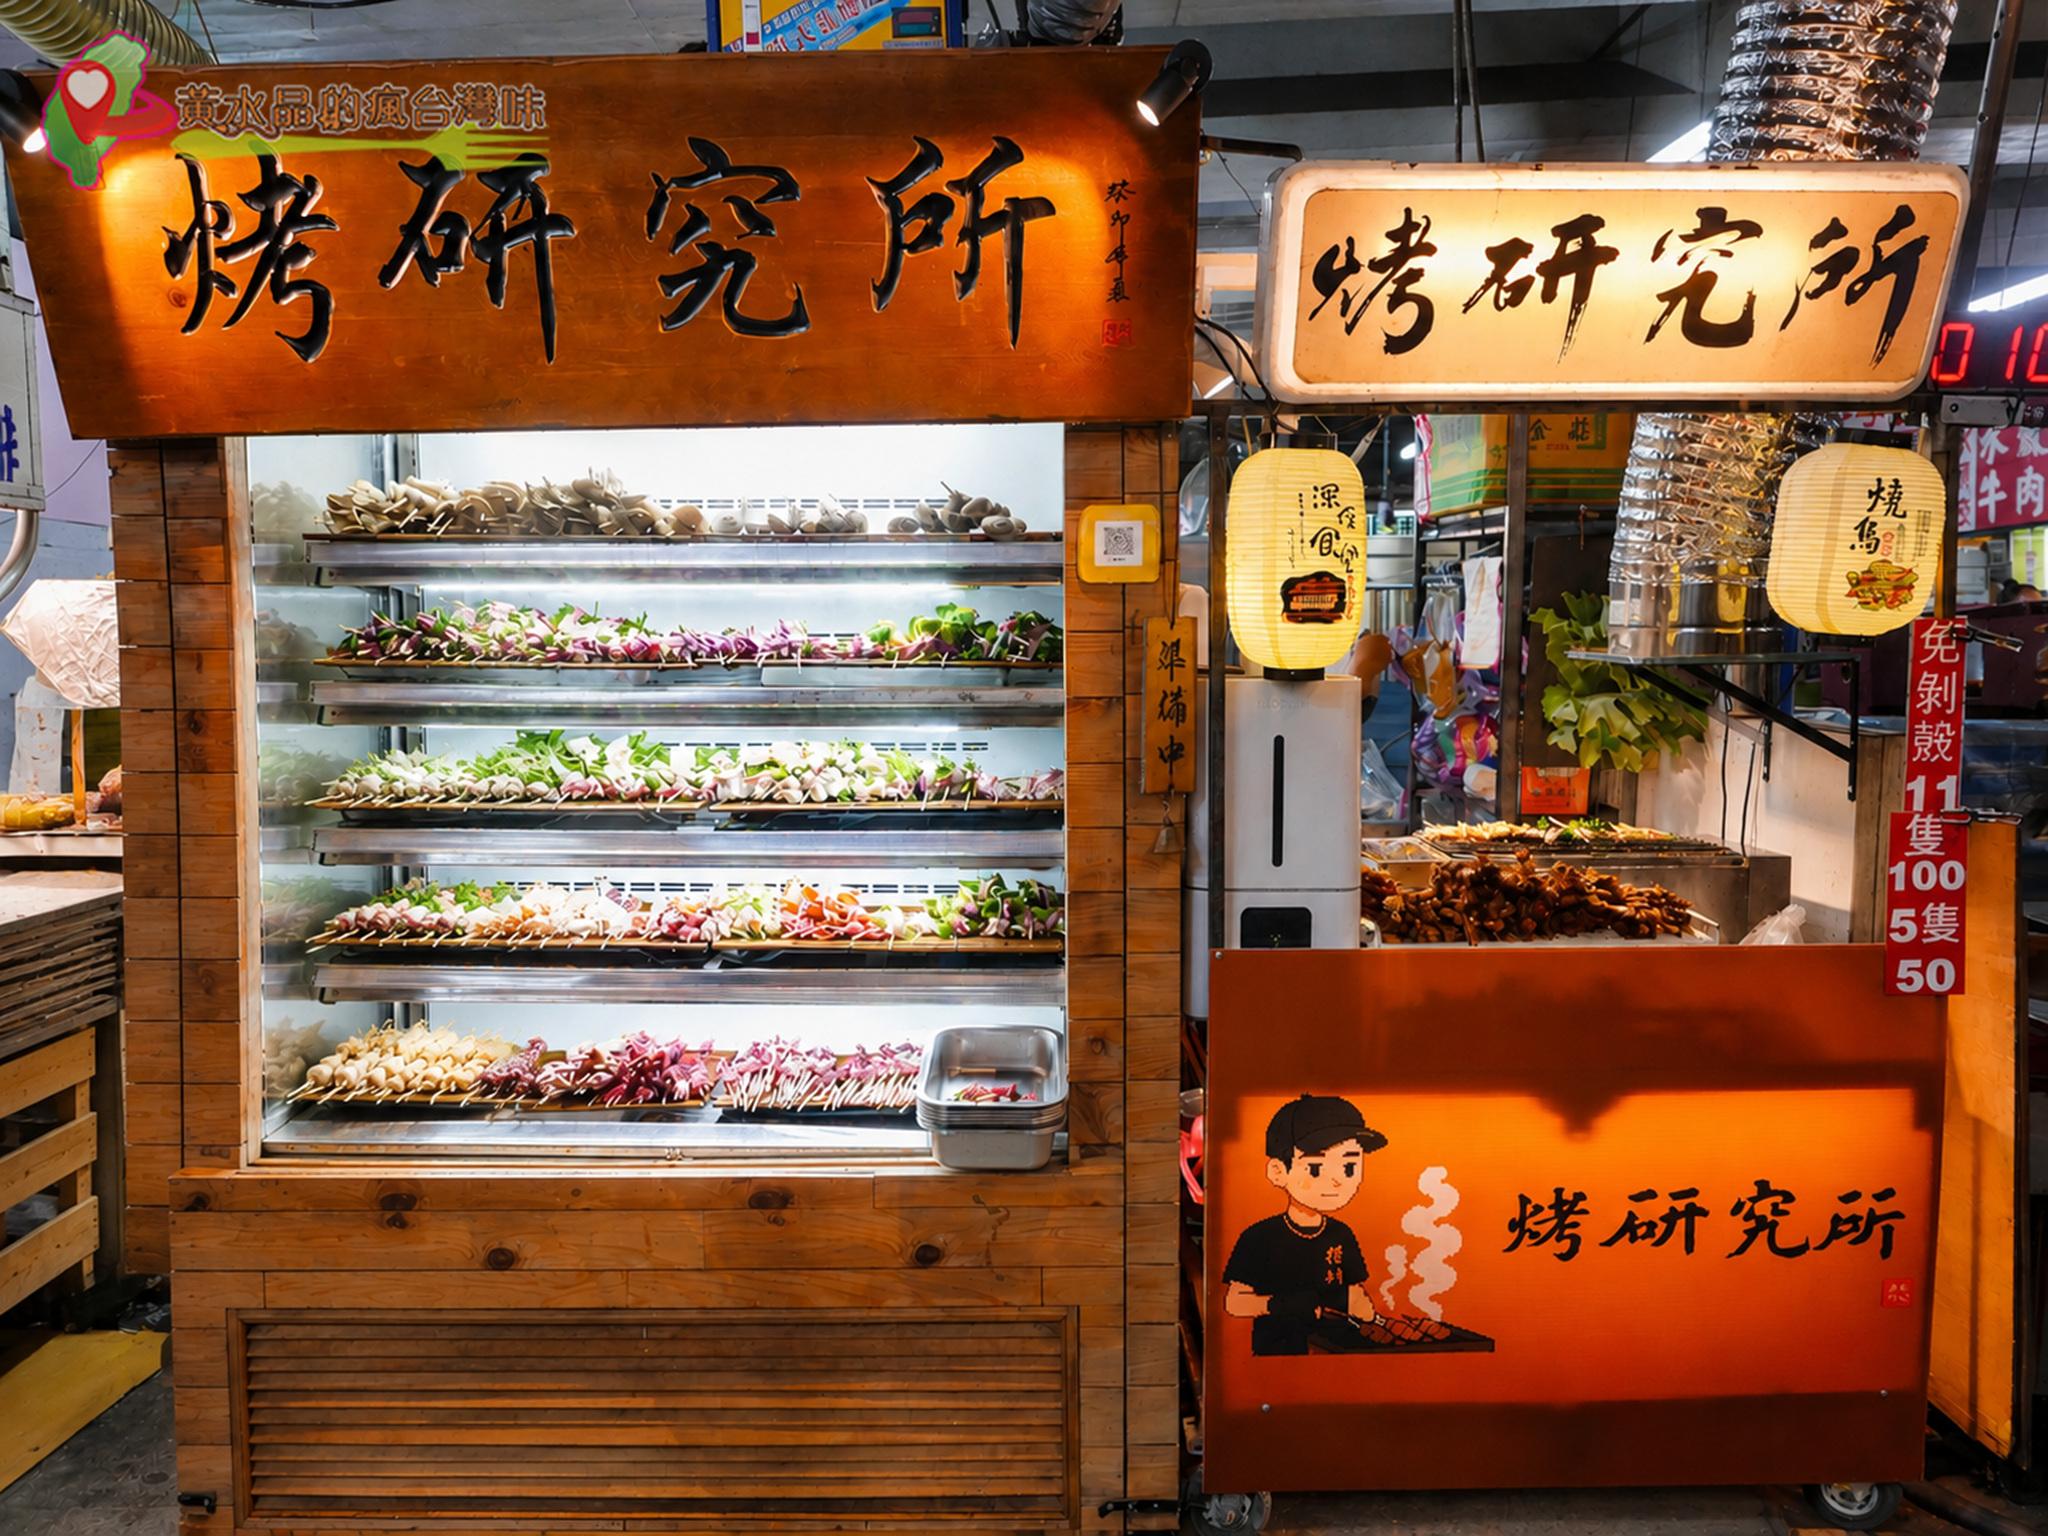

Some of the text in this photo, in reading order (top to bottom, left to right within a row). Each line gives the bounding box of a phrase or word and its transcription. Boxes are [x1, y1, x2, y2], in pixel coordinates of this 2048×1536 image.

[162, 136, 1056, 364] 烤研究所
[1308, 204, 1930, 369] 烤研究所
[1888, 860, 1966, 892] 100
[1889, 902, 1960, 945] 5隻
[1896, 958, 1956, 993] 50
[1502, 1179, 1906, 1261] 烤研究所
